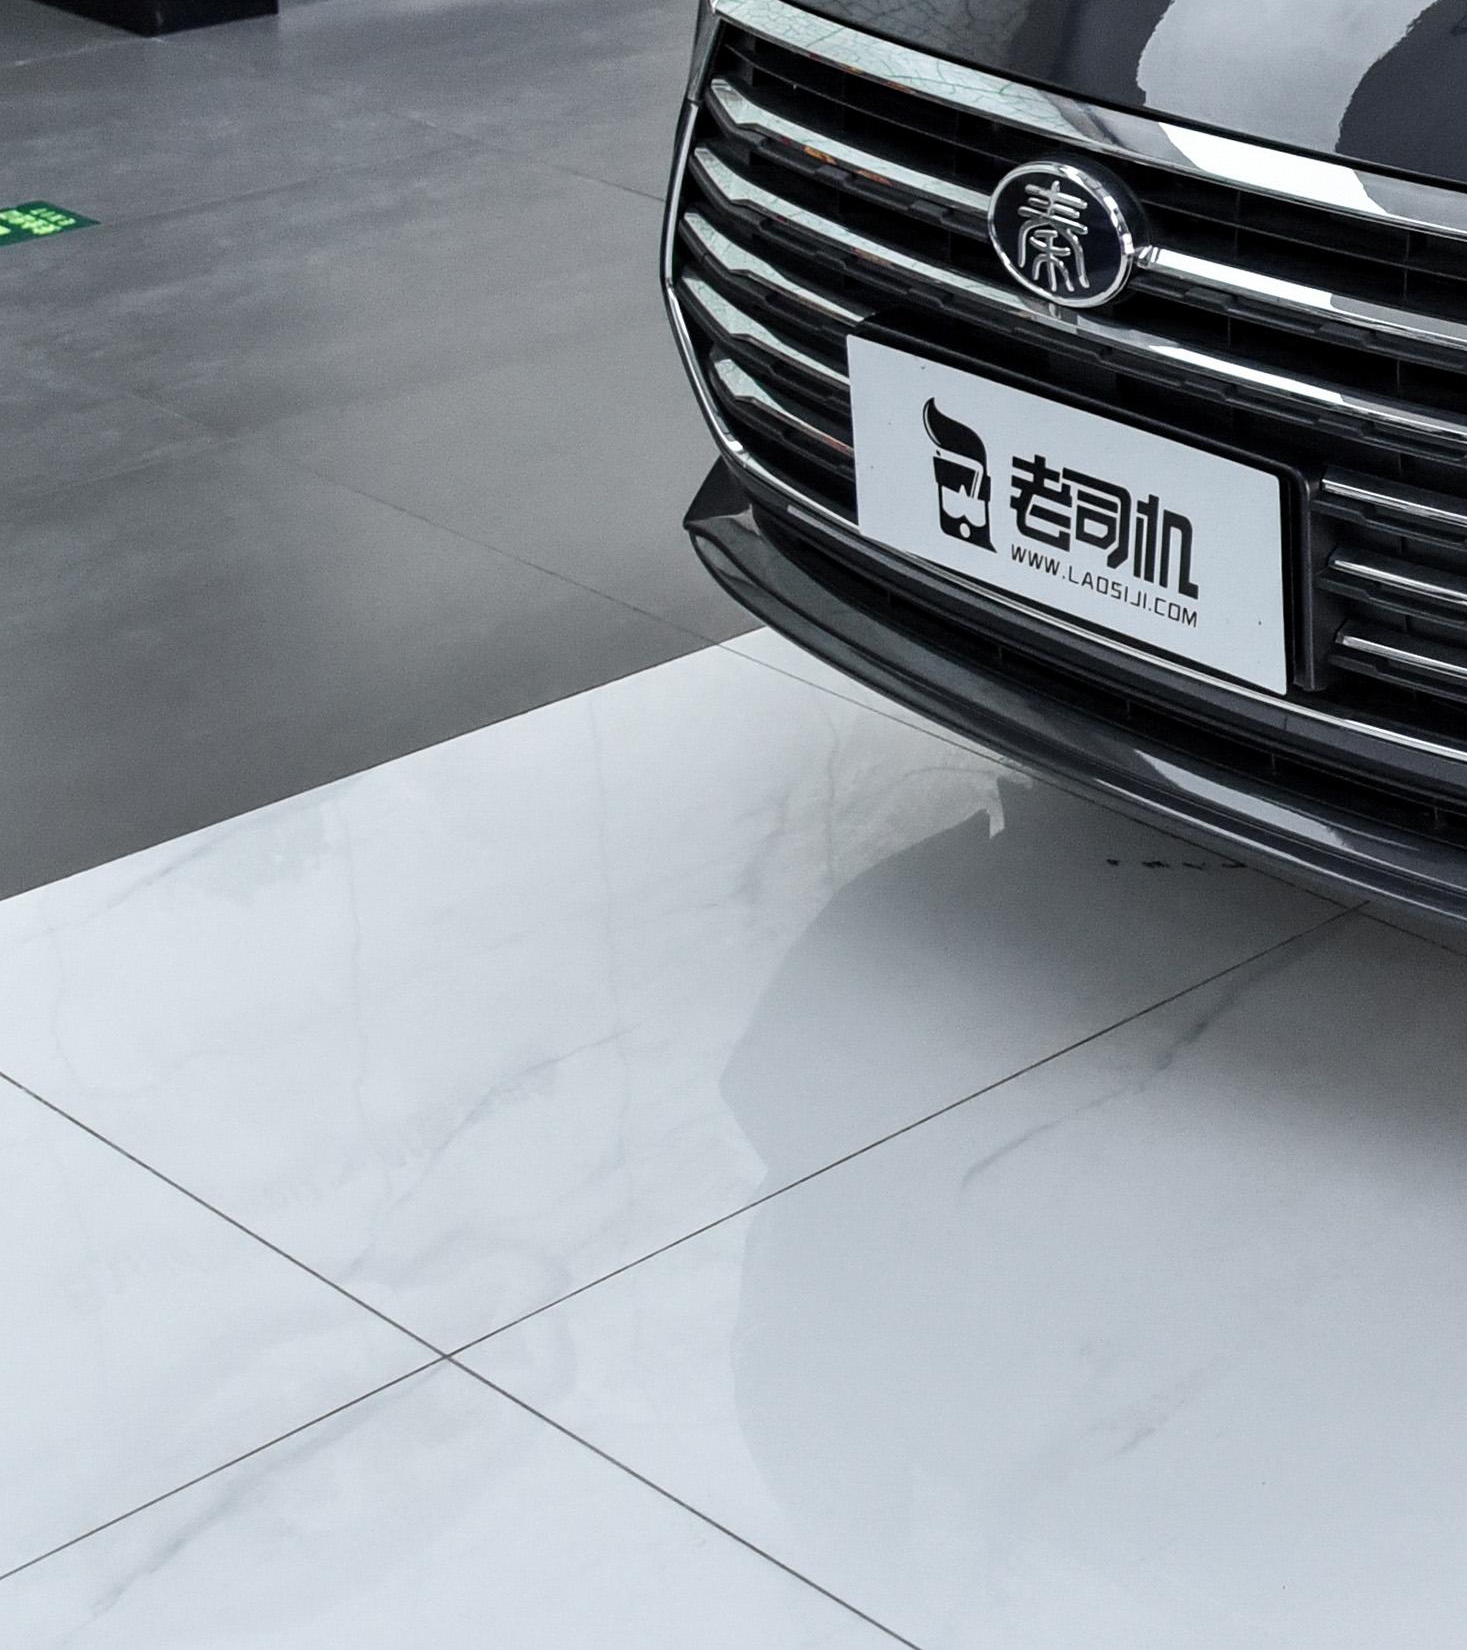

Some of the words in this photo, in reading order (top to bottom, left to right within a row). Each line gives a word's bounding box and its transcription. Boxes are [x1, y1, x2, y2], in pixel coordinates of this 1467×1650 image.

[1009, 453, 1199, 600] 老司机
[1010, 543, 1198, 629] WWW.LAOSIJI.COM
